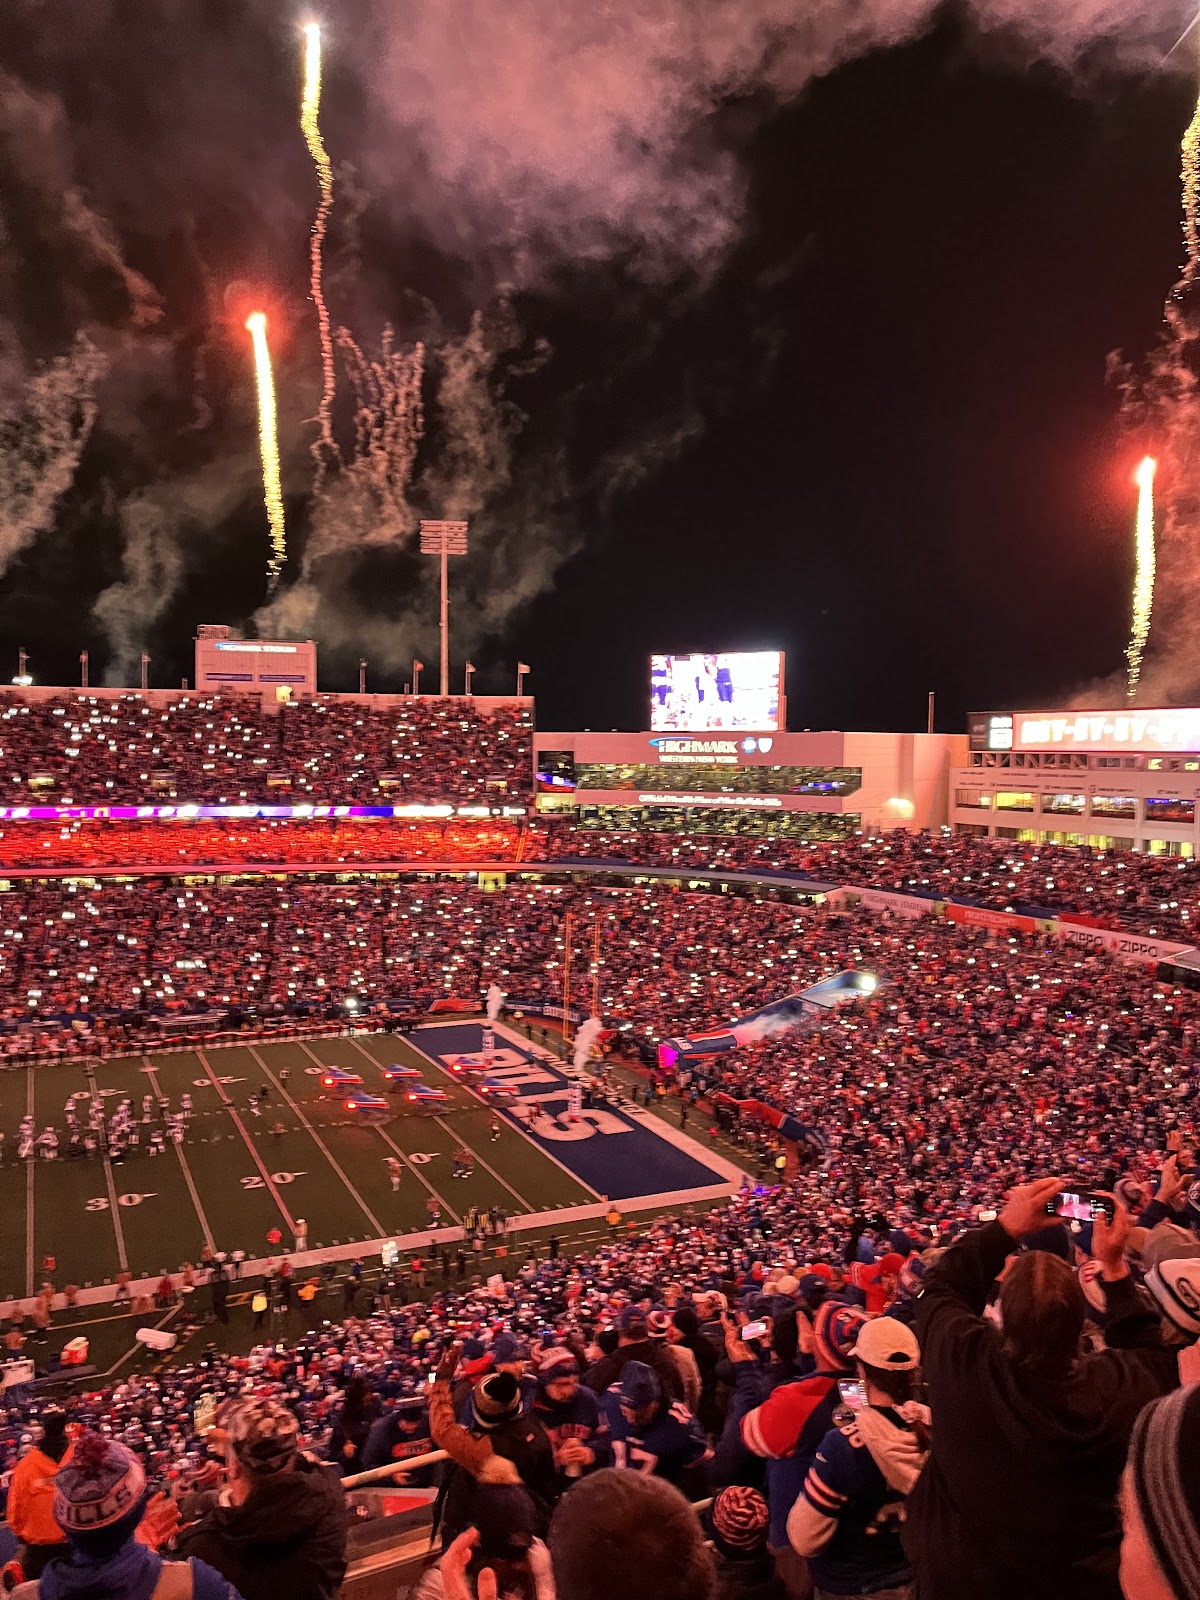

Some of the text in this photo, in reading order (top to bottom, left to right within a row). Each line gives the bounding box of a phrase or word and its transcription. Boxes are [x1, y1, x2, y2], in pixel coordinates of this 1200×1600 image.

[658, 740, 738, 753] HIGHMARK
[1067, 930, 1104, 946] ZIPPO
[1119, 940, 1158, 958] ZIPPO
[240, 1172, 295, 1189] 20
[84, 1193, 144, 1211] 30
